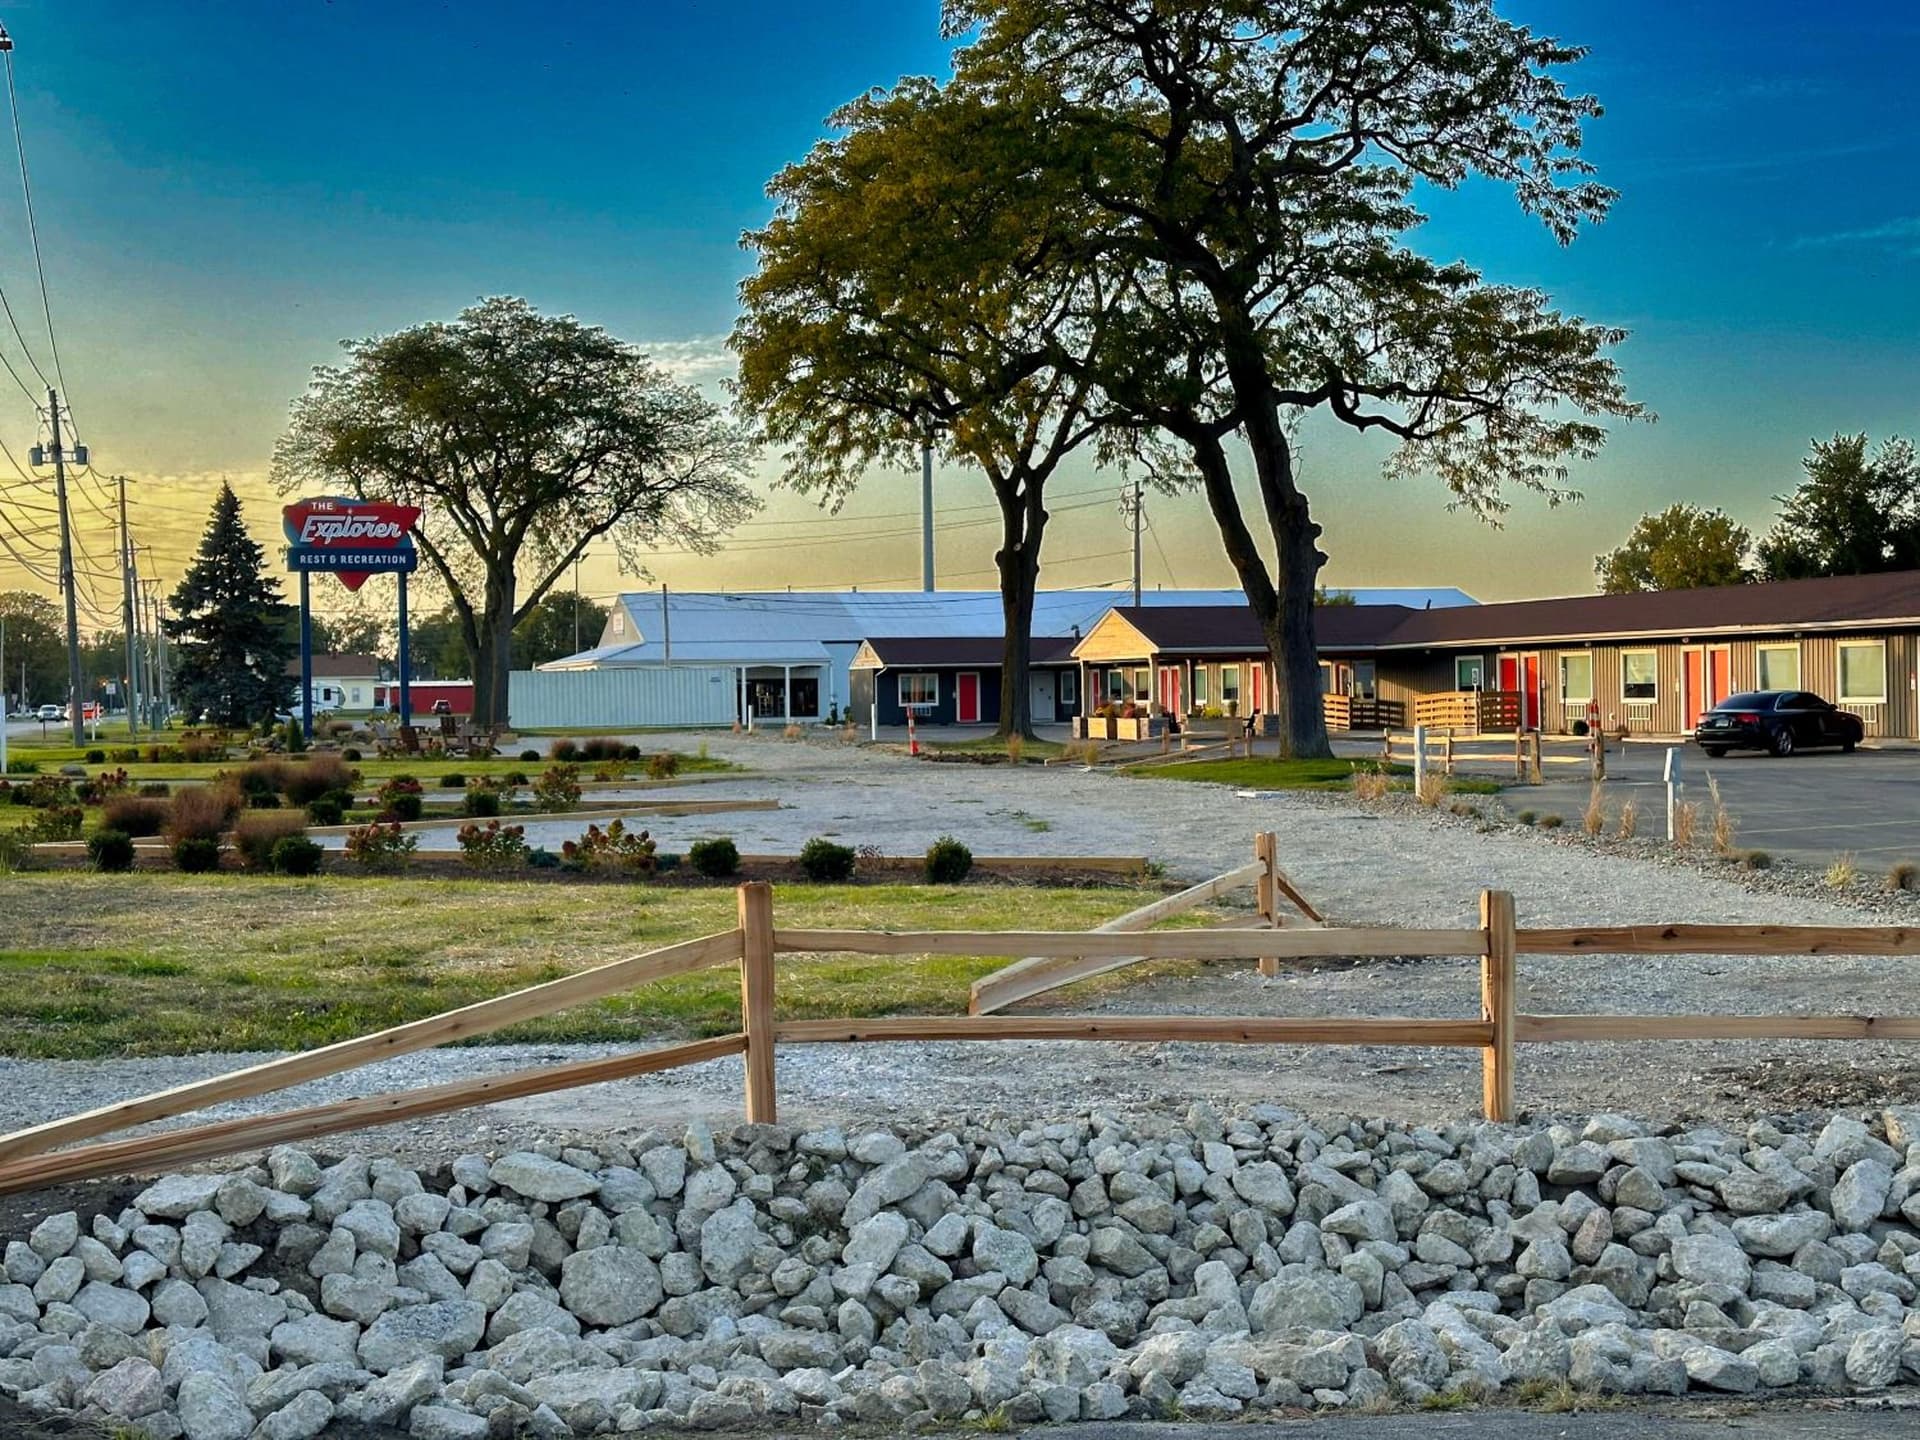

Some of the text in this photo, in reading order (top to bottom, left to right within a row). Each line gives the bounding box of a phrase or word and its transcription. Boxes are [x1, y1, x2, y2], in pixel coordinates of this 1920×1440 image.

[311, 502, 334, 510] THE
[299, 515, 402, 545] Explorer
[299, 555, 406, 564] REST & RECREATION
